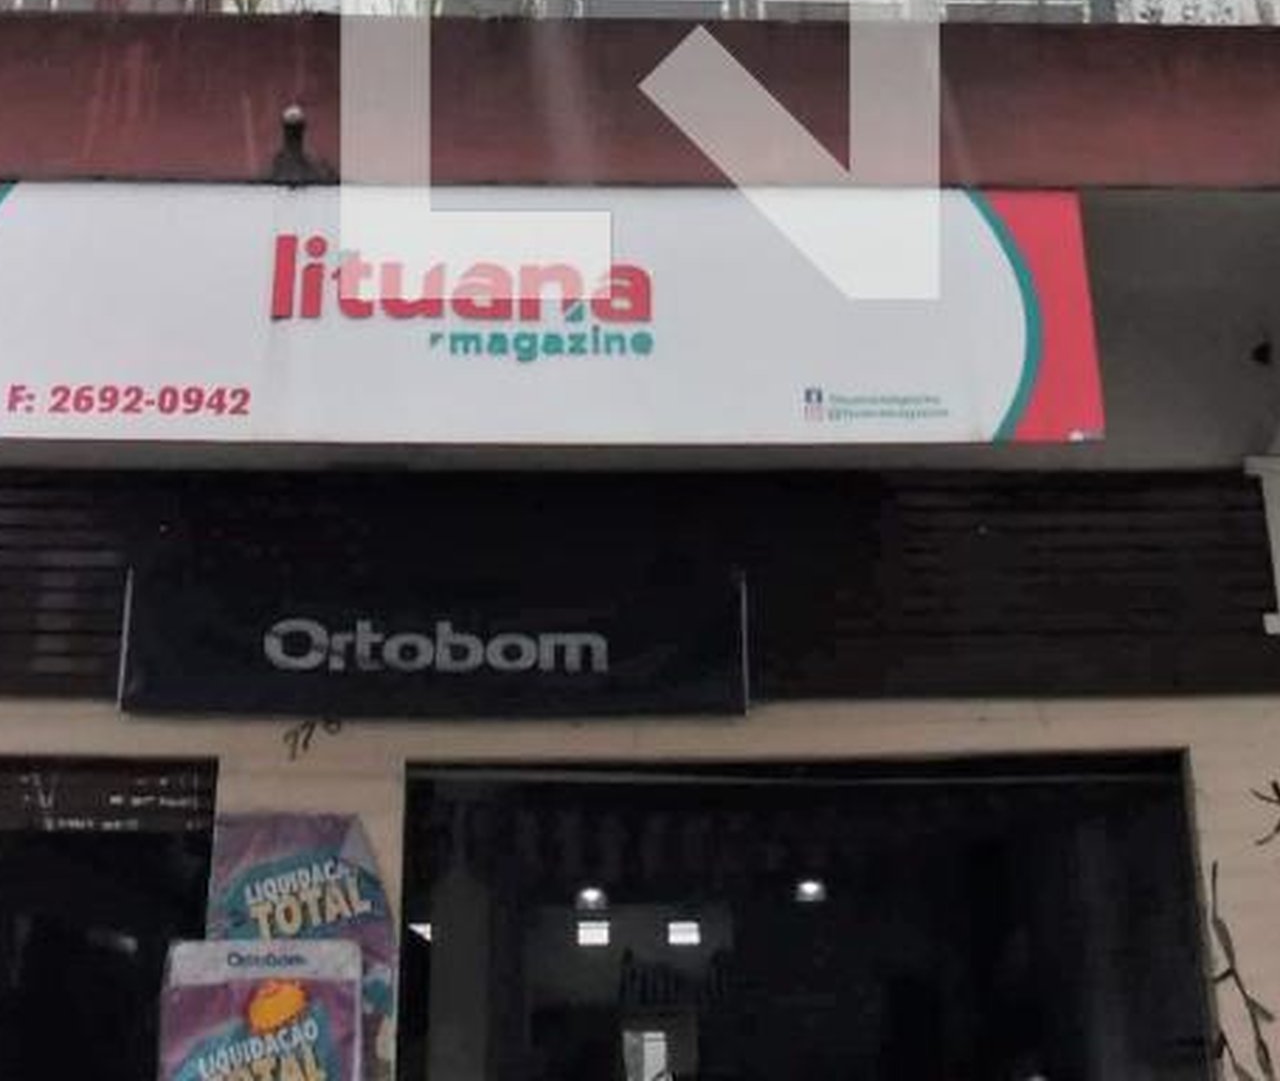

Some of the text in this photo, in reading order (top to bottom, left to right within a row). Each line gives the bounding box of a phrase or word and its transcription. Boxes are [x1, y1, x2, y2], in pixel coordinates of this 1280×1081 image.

[271, 235, 653, 322] lituana
[450, 325, 654, 362] magazine
[6, 384, 252, 415] F: 2692-0942
[263, 618, 608, 673] Ortobom
[250, 870, 370, 943] TOTAL
